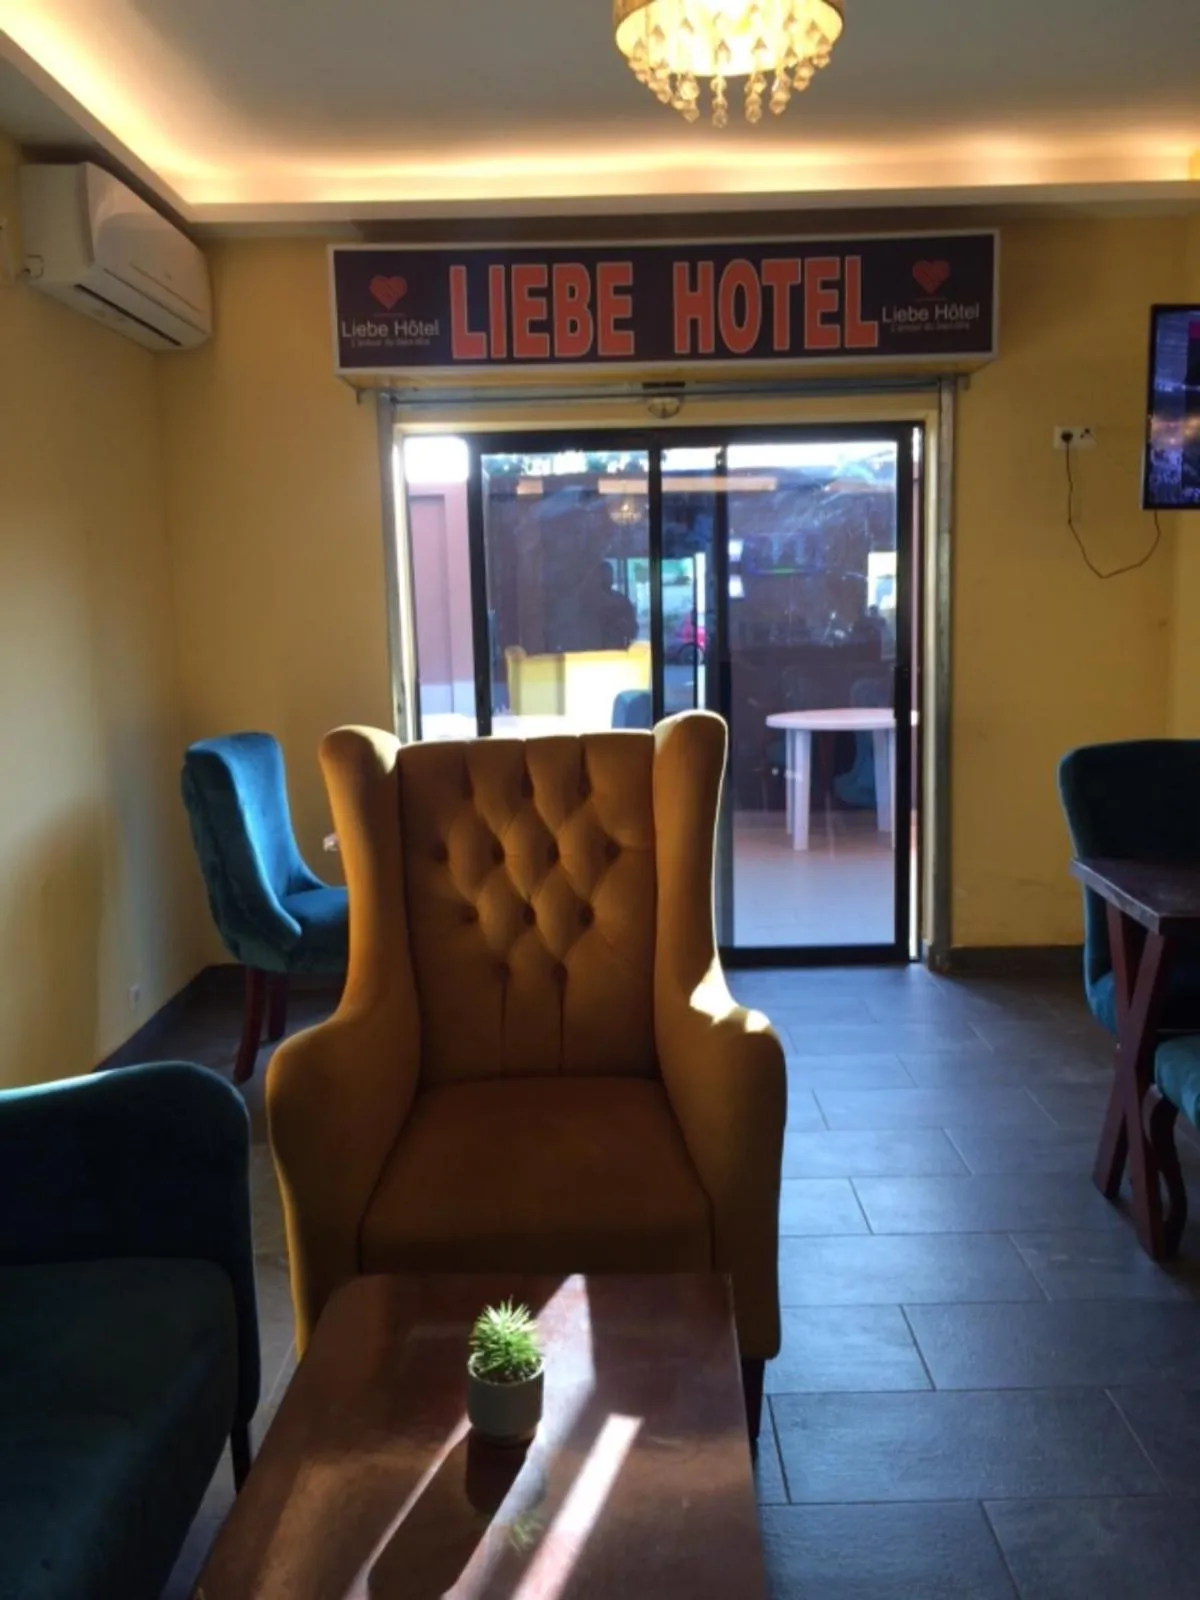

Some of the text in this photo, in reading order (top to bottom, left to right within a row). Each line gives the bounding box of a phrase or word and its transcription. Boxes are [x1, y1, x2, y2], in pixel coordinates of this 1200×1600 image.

[449, 255, 879, 359] LIEBE HOTEL
[882, 302, 980, 323] Liebe Hôtel
[341, 318, 440, 338] Liebe Hôtel
